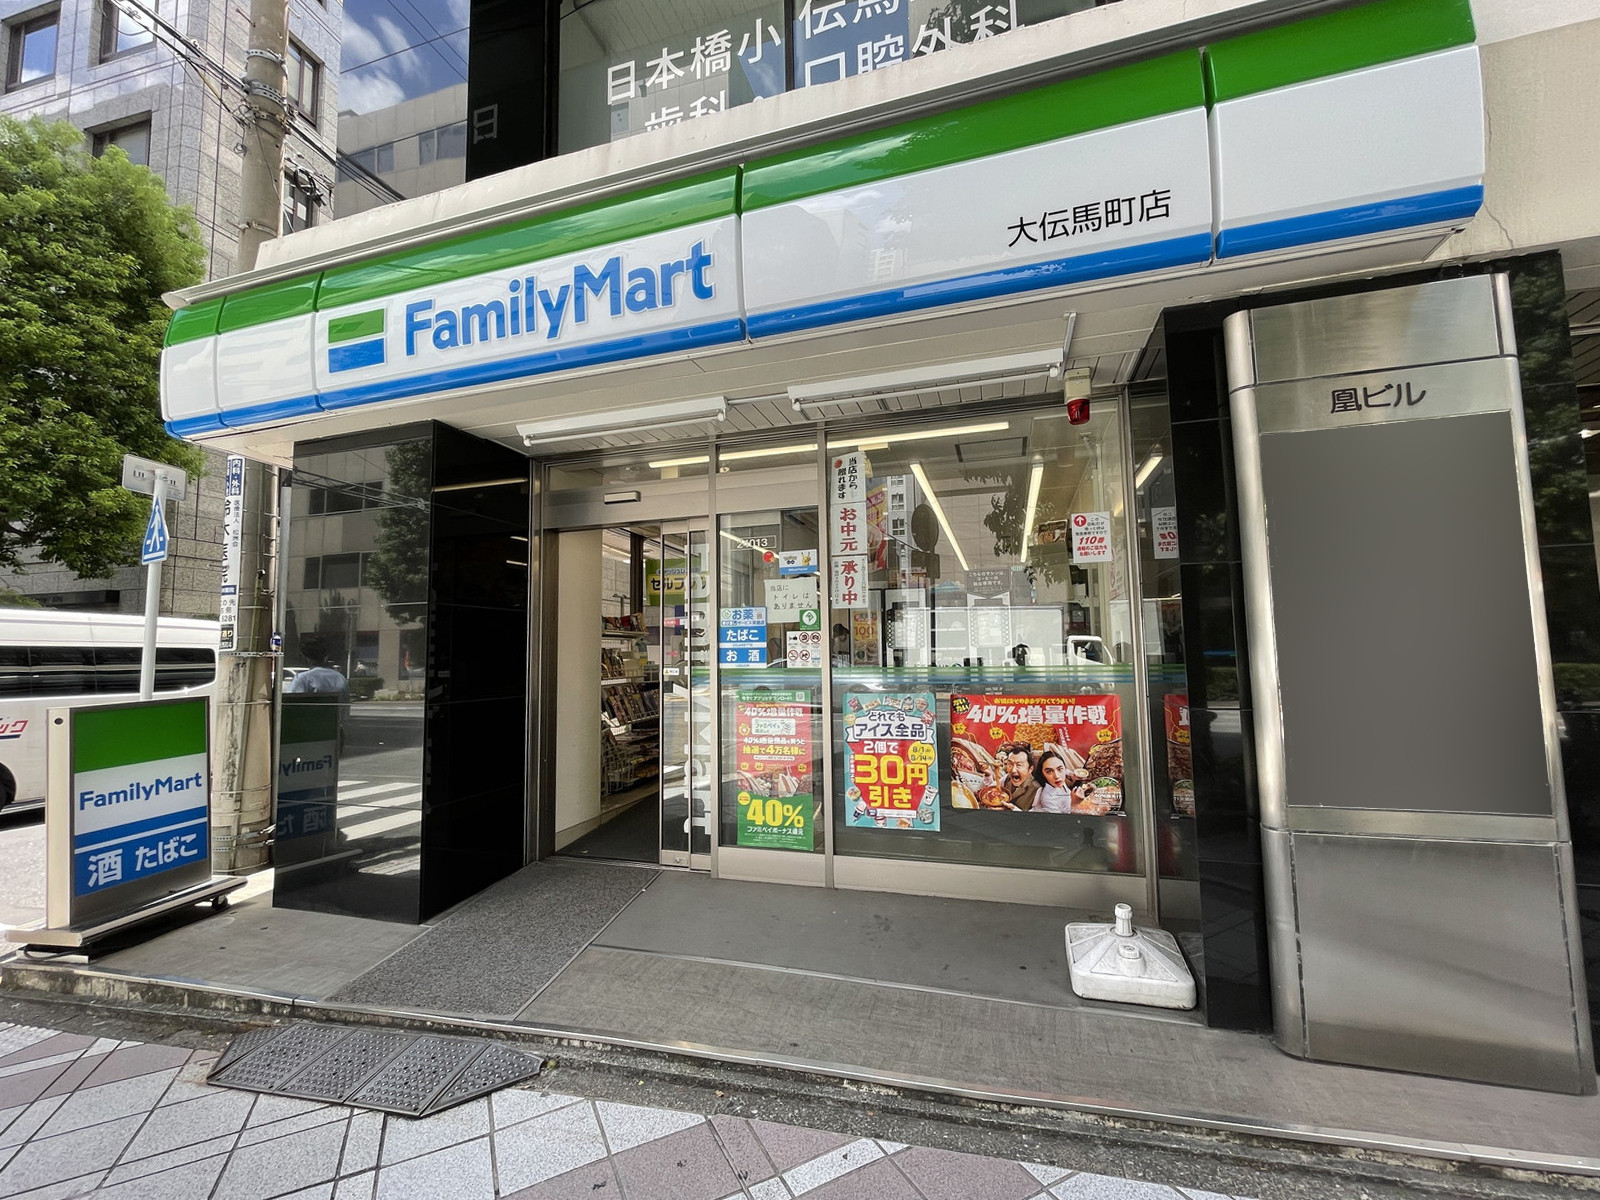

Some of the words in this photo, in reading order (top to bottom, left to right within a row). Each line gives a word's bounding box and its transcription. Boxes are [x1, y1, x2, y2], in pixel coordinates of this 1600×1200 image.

[1007, 189, 1171, 247] 大伝馬町店
[405, 240, 714, 357] FamilyMart
[847, 457, 859, 490] 当店から
[839, 507, 858, 553] お中元
[736, 538, 769, 549] 24013
[840, 560, 859, 606] 承り中
[732, 608, 754, 620] お薬
[773, 602, 813, 610] ありません
[726, 629, 759, 641] たばこ
[726, 649, 760, 662] お酒
[868, 711, 906, 721] どれでも
[966, 704, 1109, 725] 40%増量作戦
[855, 723, 926, 738] アイス全品
[863, 741, 899, 754] 2個で
[854, 754, 929, 786] 30円
[78, 772, 203, 811] FamilyMart
[868, 785, 912, 809] 引き
[746, 798, 804, 828] 40%
[87, 850, 123, 888] 酒
[135, 832, 198, 872] たばこ
